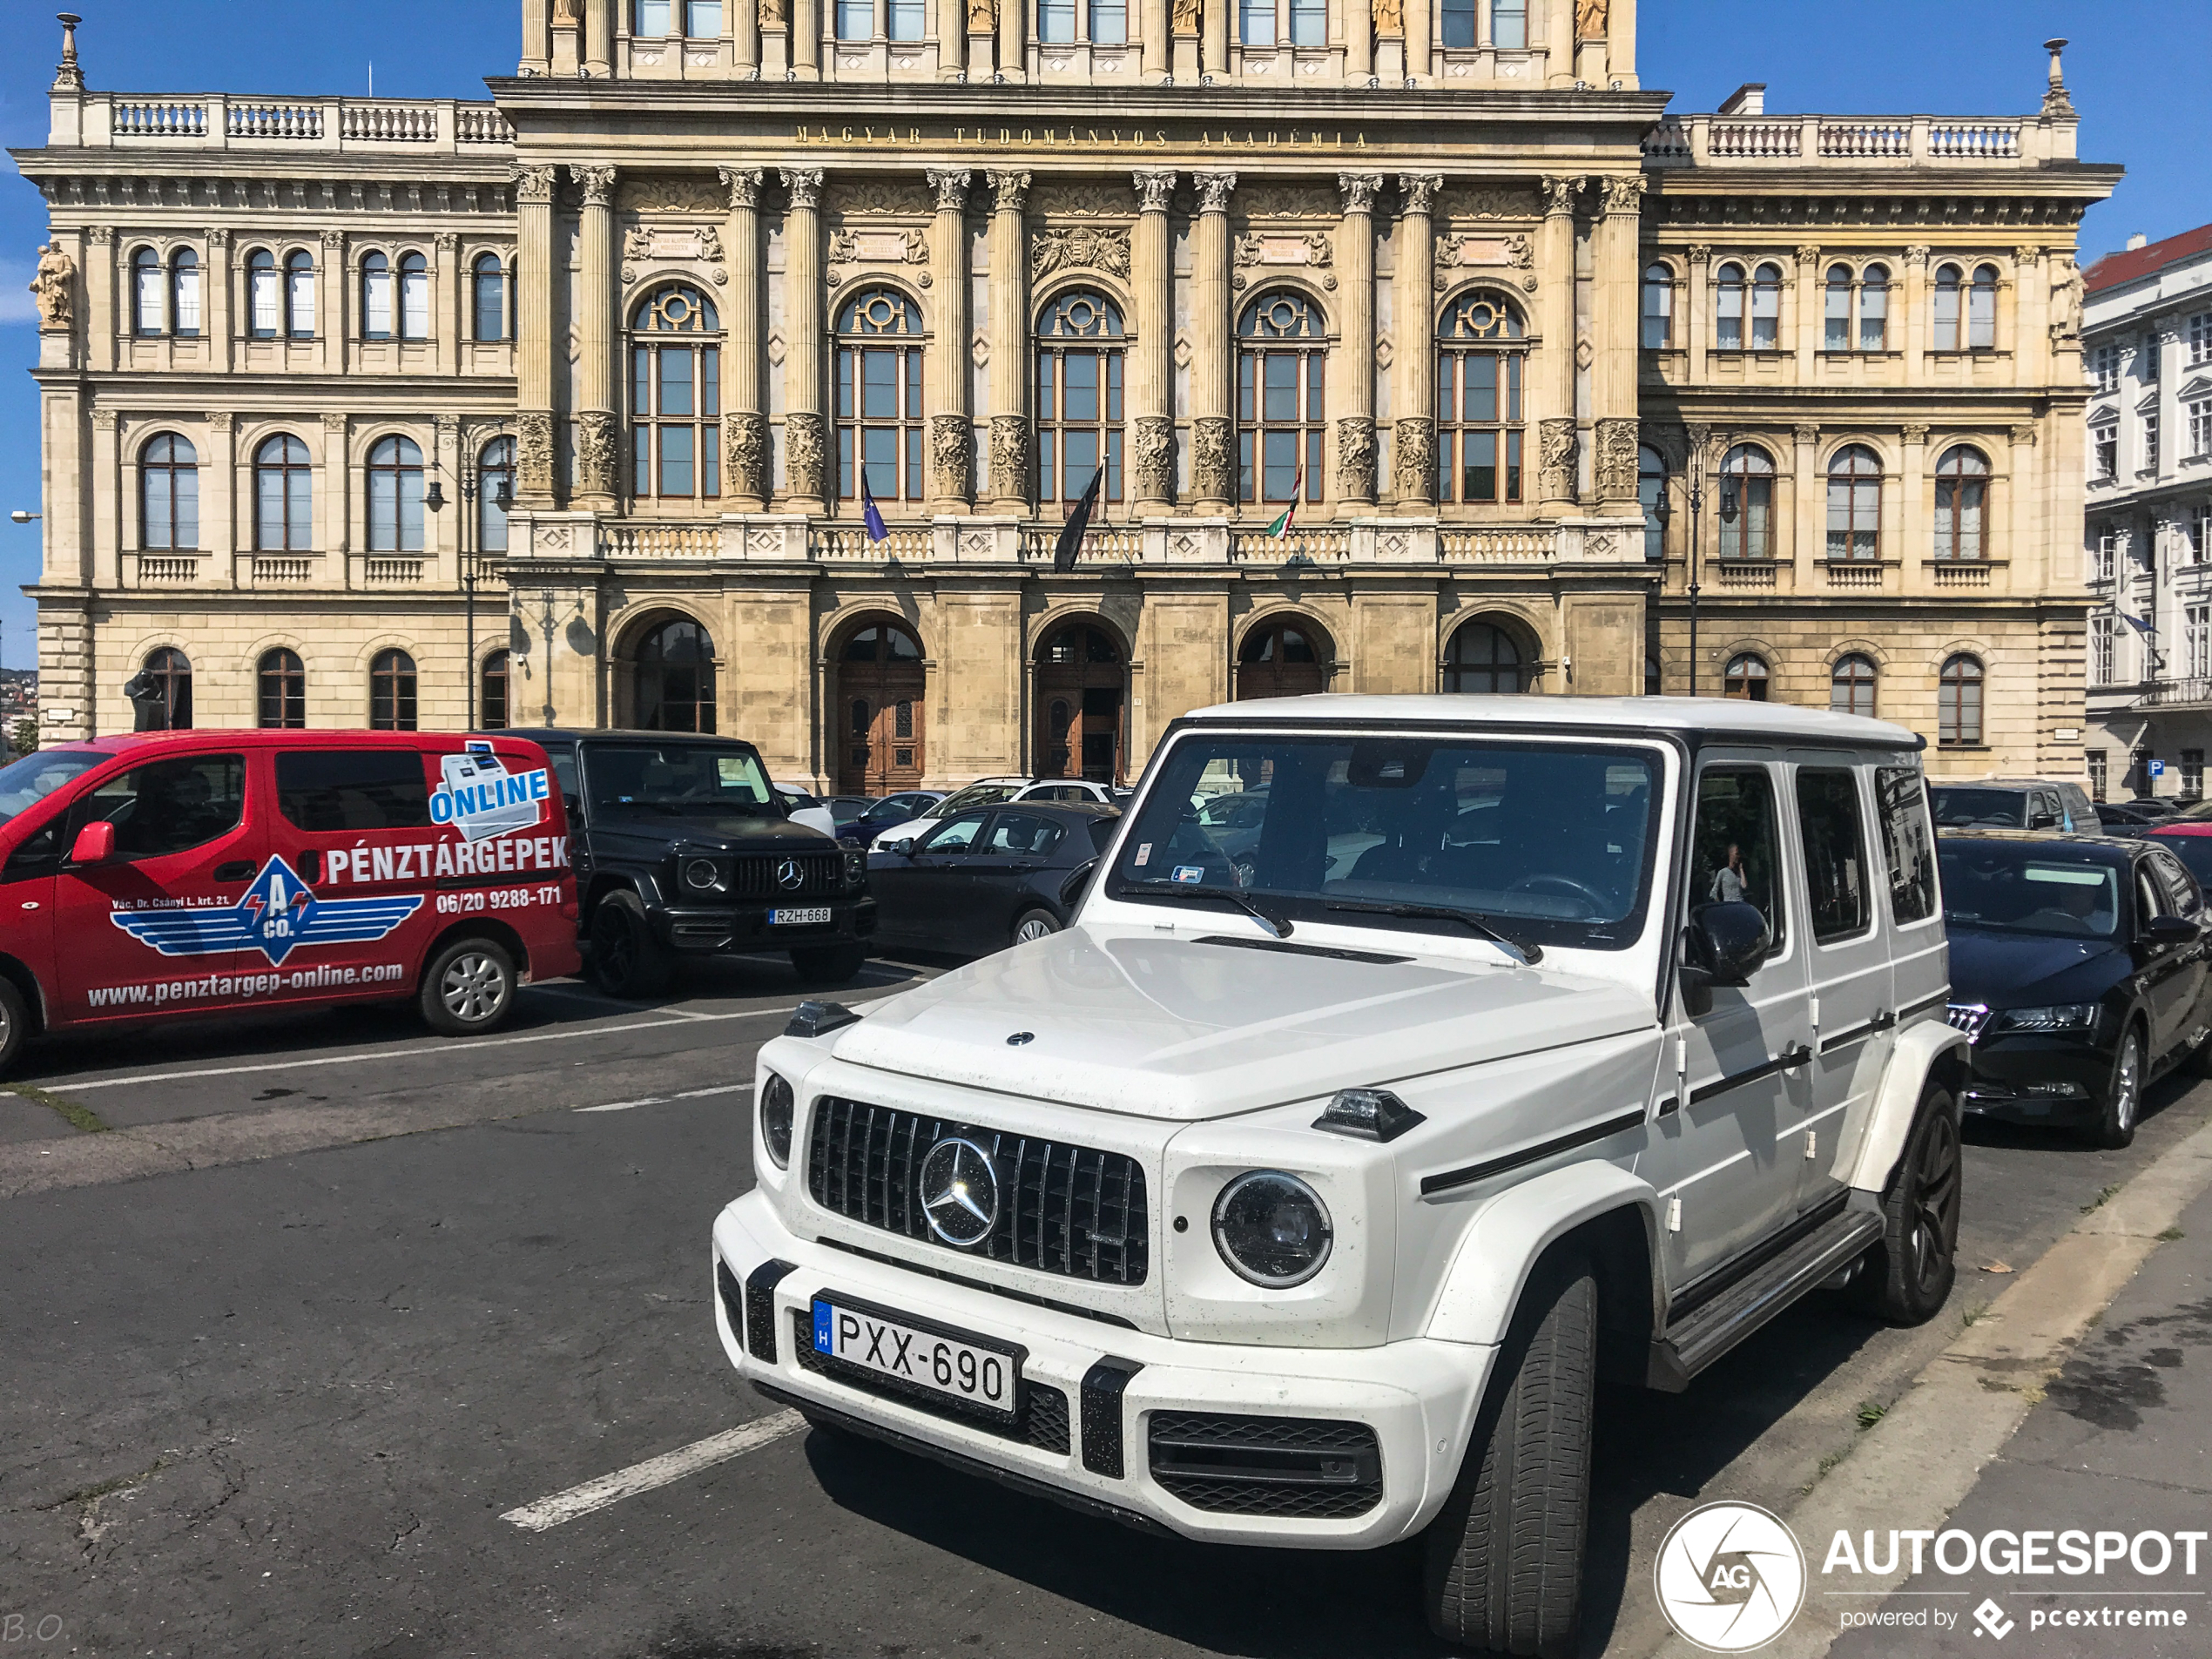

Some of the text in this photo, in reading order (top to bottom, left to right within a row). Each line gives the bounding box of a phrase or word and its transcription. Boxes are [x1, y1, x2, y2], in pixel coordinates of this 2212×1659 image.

[795, 125, 1366, 149] MAGYAR TUDOMÁNYOS AKADÉMIA
[2151, 761, 2162, 774] P
[431, 770, 548, 823] ONLINE
[327, 833, 569, 885] PÉNZTÁRGÉPEK
[111, 895, 230, 910] Vác, Dr. Csányi L. krt. 21.
[267, 873, 288, 917] A
[436, 885, 562, 914] 06/20 9288-171
[777, 908, 829, 922] RZH-668
[87, 963, 403, 1007] www.penztargep-online.com
[839, 1313, 1002, 1401] PXX-690
